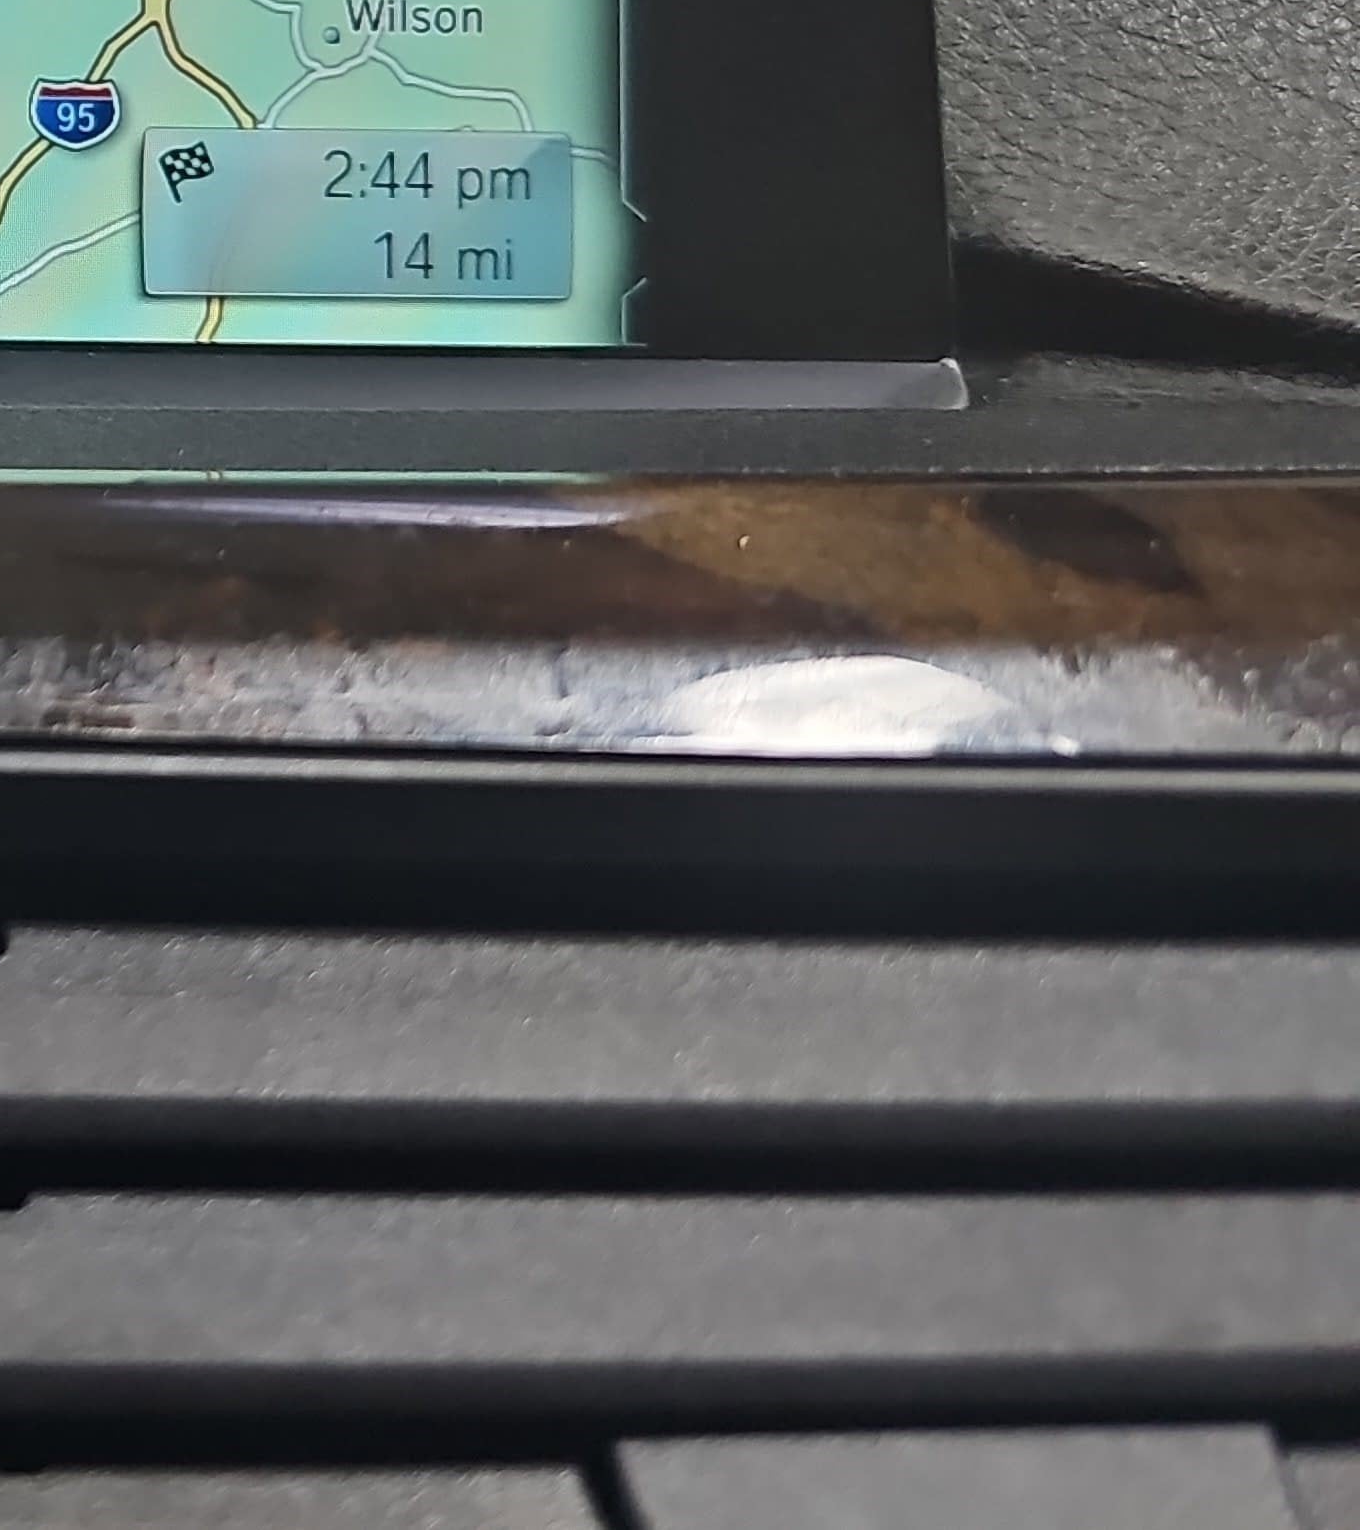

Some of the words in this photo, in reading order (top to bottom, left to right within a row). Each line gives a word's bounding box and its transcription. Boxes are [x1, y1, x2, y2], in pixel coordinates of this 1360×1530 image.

[346, 0, 482, 33] Wilson
[56, 104, 95, 132] 95
[323, 150, 433, 199] 2:44
[458, 165, 530, 208] pm
[375, 233, 434, 279] 14
[458, 238, 512, 280] mi
